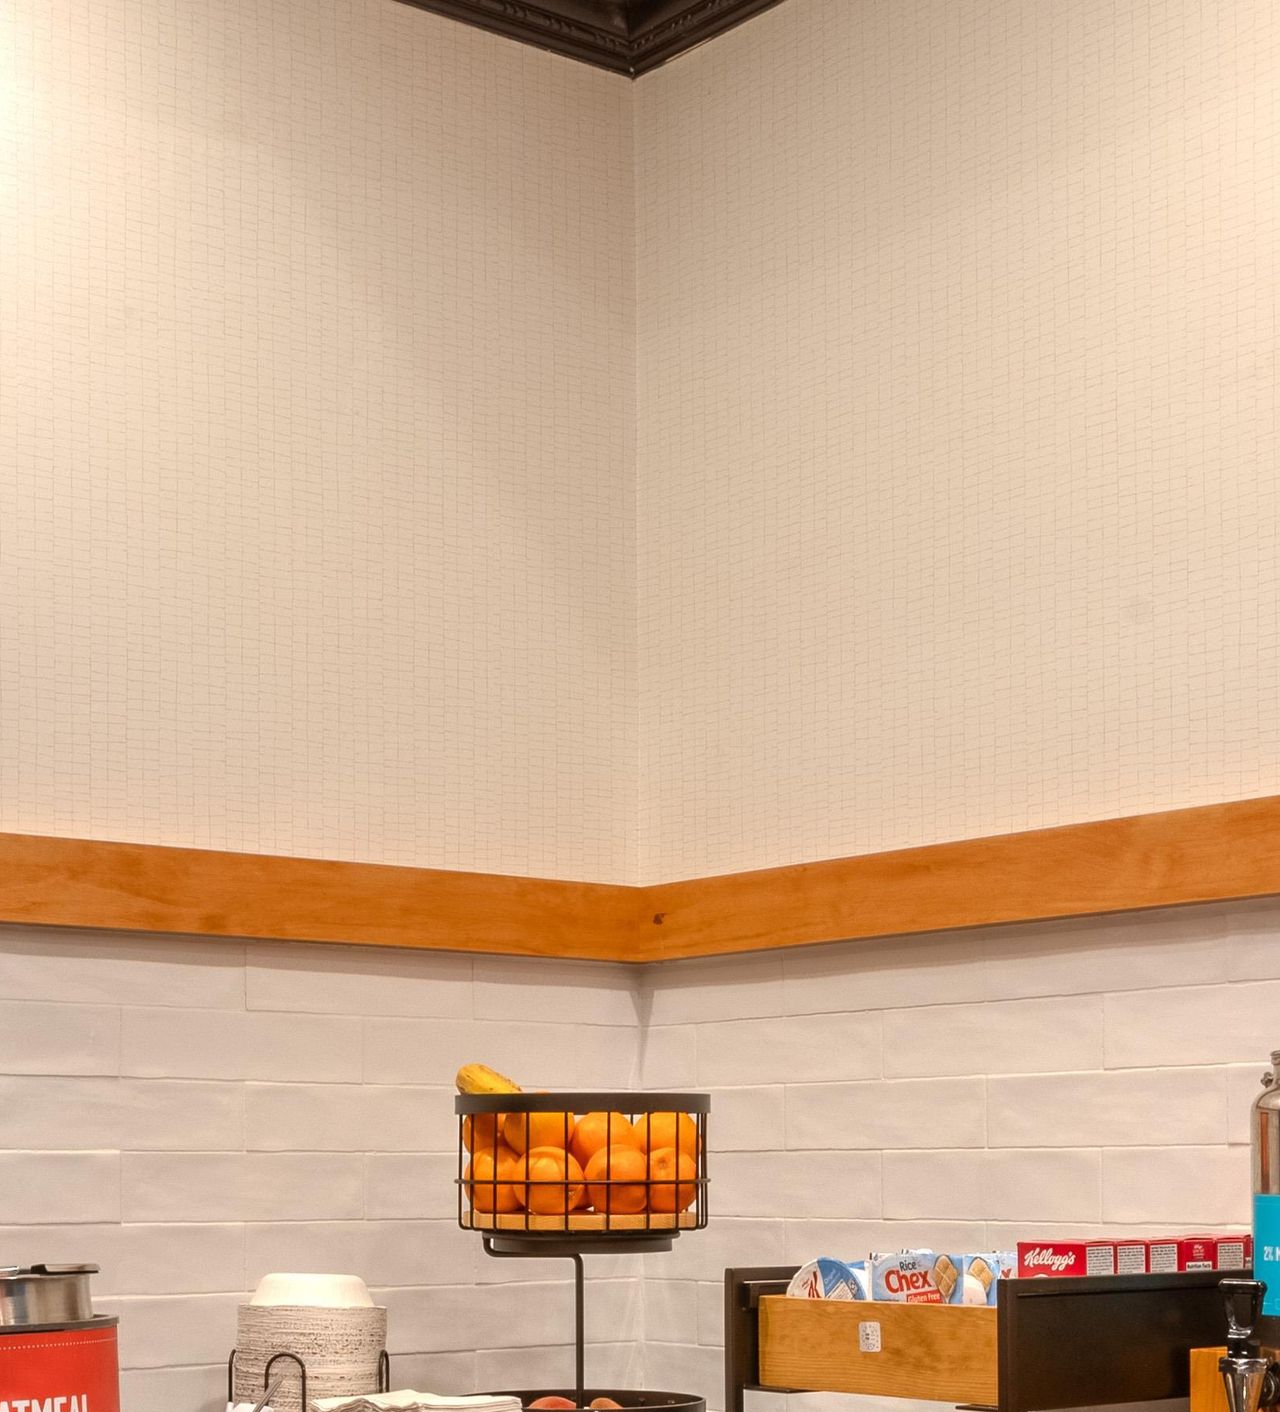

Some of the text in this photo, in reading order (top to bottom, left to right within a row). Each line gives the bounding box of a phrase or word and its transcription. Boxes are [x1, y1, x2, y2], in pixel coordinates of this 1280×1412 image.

[1024, 1247, 1076, 1271] Kellogg's
[1263, 1245, 1274, 1261] 2%
[899, 1260, 917, 1272] Rice
[884, 1269, 932, 1294] Chex
